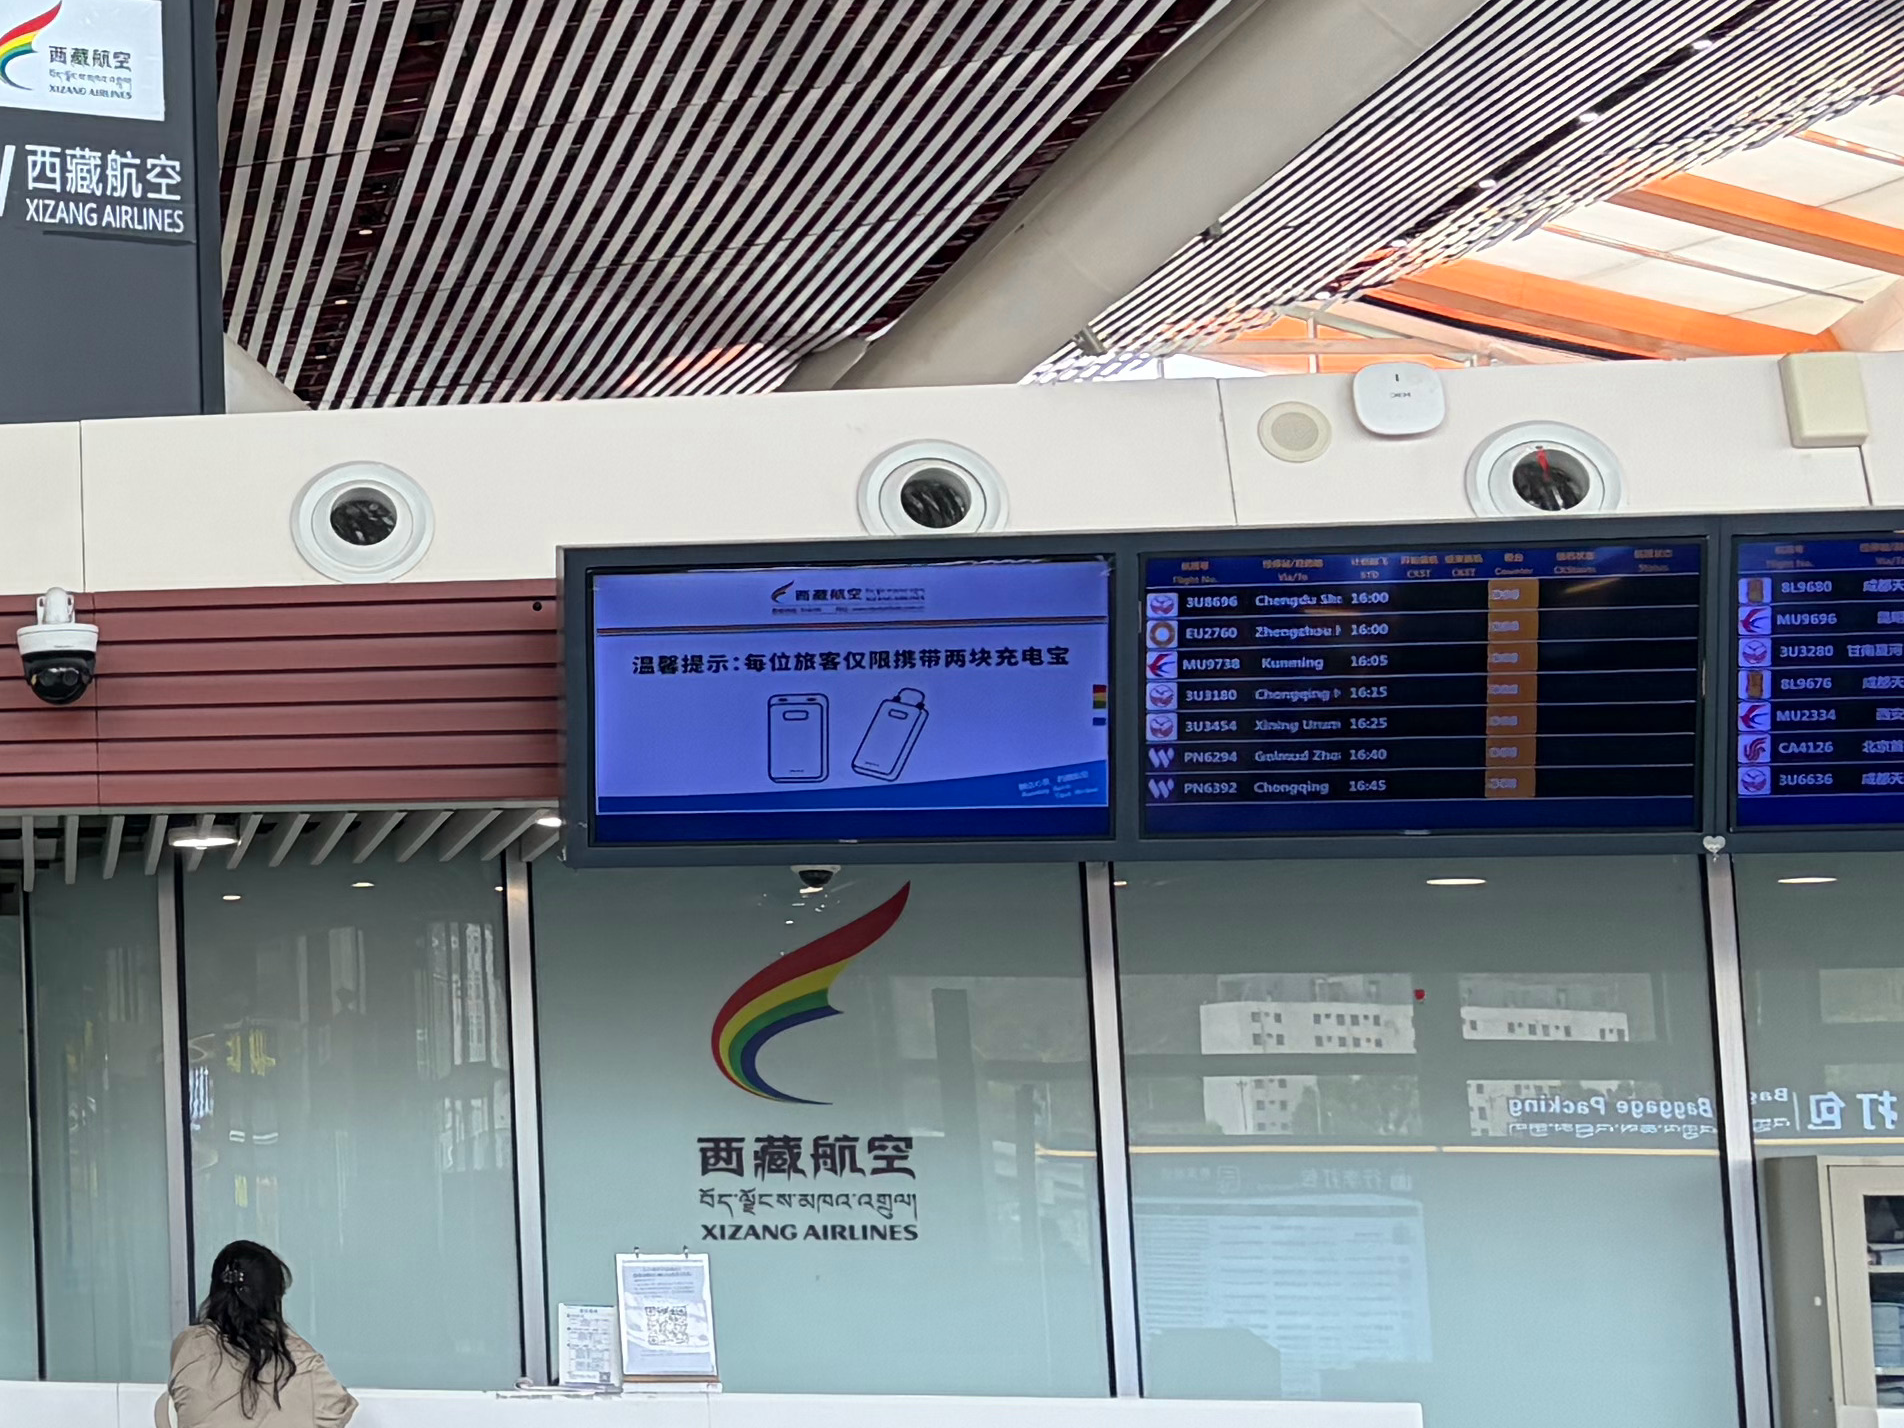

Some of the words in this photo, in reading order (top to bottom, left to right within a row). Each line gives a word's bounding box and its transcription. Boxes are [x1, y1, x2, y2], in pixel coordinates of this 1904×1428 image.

[49, 45, 132, 72] 西藏航空
[49, 84, 87, 95] XIZANG
[88, 88, 132, 100] AIRLINES
[25, 144, 182, 201] 西藏航空
[26, 198, 98, 226] XIZANG
[102, 205, 184, 233] AIRLINES
[1781, 582, 1832, 593] 8L9680
[1186, 597, 1238, 607] 3U8696
[1351, 592, 1389, 603] 16:00
[1777, 614, 1837, 625] MU9696
[1186, 628, 1237, 639] EU2760
[1351, 624, 1388, 635] 16:00
[1779, 646, 1833, 657] 3U3280
[1262, 658, 1324, 670] Kunming
[1351, 655, 1388, 666] 16:05
[1781, 678, 1832, 689] 8L9676
[1186, 690, 1237, 701] 3U3180
[1350, 687, 1387, 698] 16:15
[1776, 710, 1836, 721] MU2334
[1185, 721, 1237, 732] 3U3454
[1350, 718, 1387, 729] 16:25
[1778, 742, 1833, 753] CA4126
[1184, 751, 1237, 762] PN6294
[1350, 750, 1387, 760] 16:40
[1779, 774, 1833, 785] 3U6636
[1184, 782, 1237, 793] PN6392
[1254, 781, 1329, 795] Chongqing
[1349, 781, 1386, 791] 16:45
[697, 1134, 916, 1182] 西藏航空
[701, 1224, 797, 1240] XIZANG
[803, 1224, 918, 1241] AIRLINES
